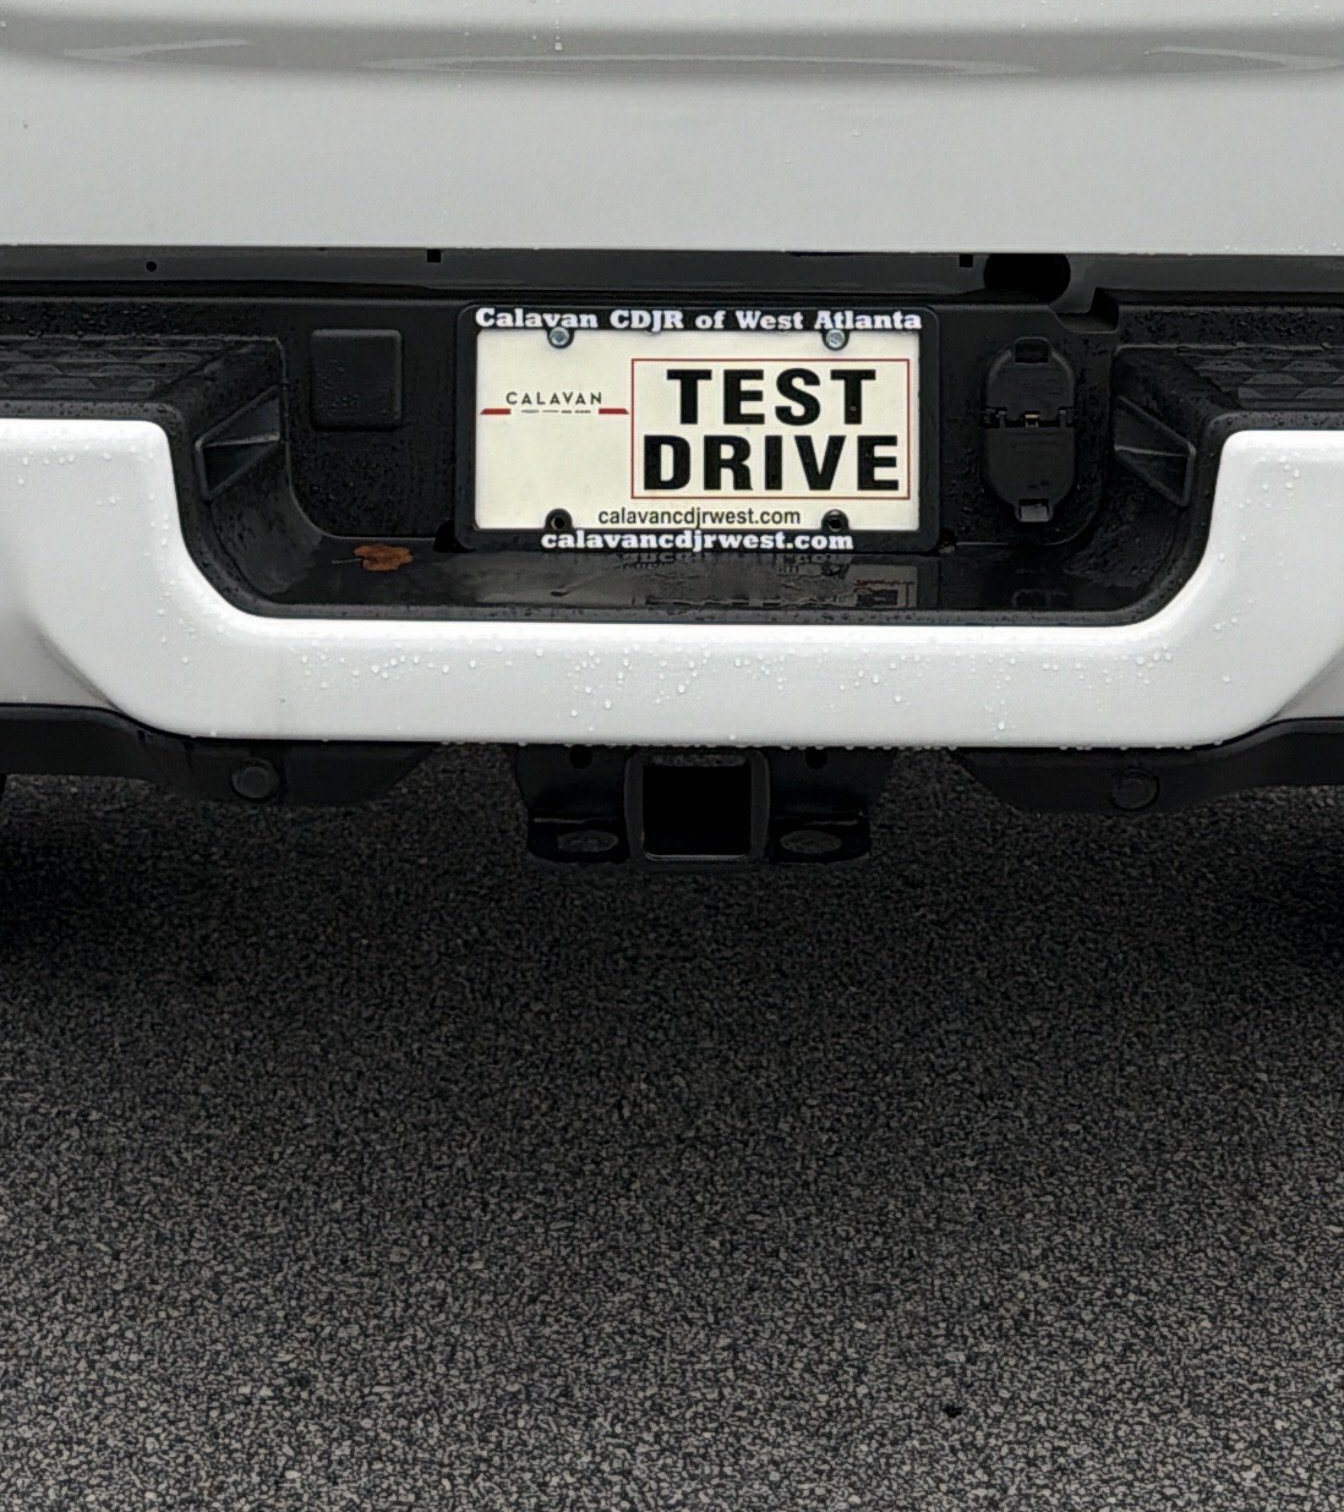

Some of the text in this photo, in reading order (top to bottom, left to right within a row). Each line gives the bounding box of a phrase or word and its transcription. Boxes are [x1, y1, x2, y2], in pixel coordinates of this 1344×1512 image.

[475, 308, 922, 330] Calavan CDJR of West Atlanta
[506, 391, 602, 405] CALAVAN
[666, 367, 876, 426] TEST
[643, 434, 899, 491] DRIVE
[598, 507, 801, 529] calavancdjrwest.com
[541, 529, 854, 552] calavancdjrwest.com
